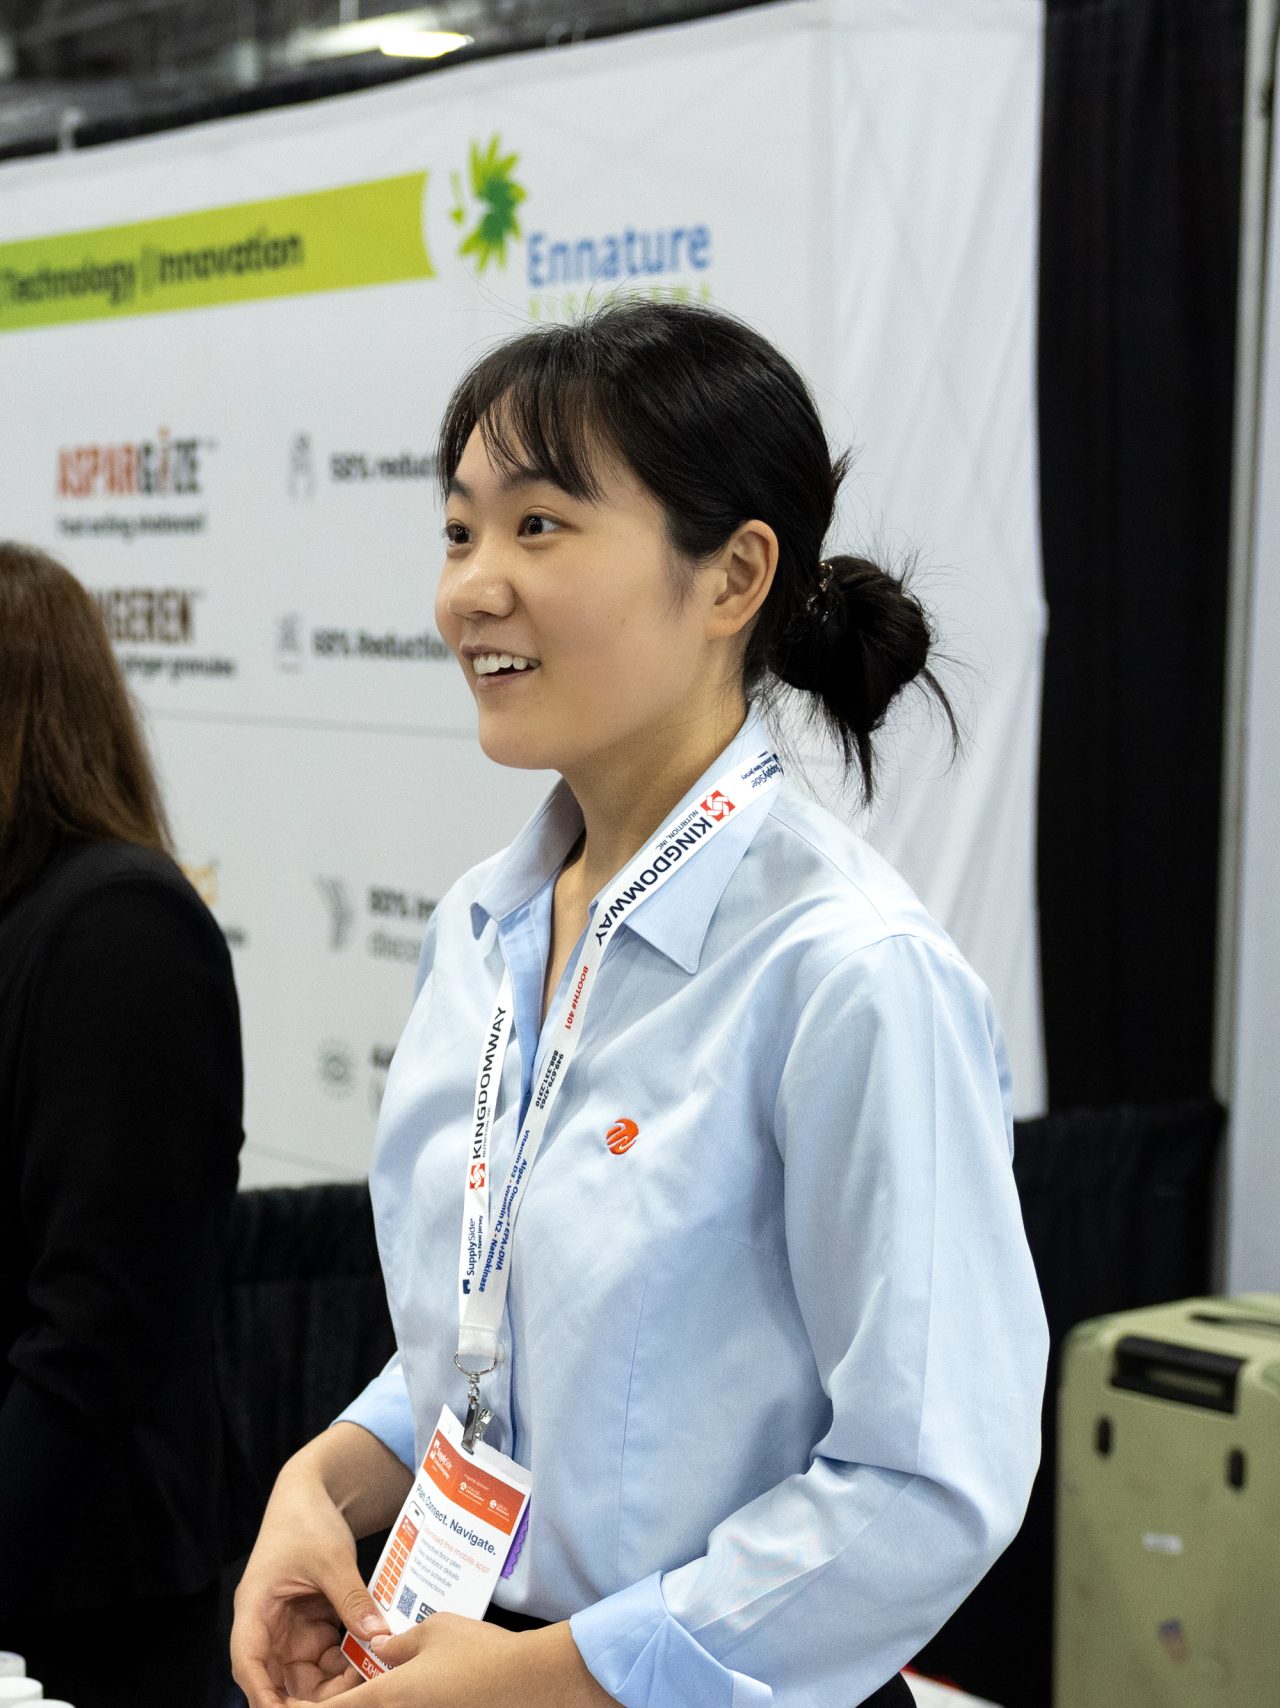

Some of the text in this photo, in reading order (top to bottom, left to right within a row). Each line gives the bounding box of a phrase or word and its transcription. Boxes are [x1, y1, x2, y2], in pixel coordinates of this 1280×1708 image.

[1, 260, 136, 306] Technology
[156, 227, 305, 285] Innovation
[528, 224, 711, 288] Ennature
[667, 810, 699, 840] NUTRITION,
[595, 816, 713, 946] KINGDOMWAY
[564, 965, 589, 1031] BOOTH# 401
[472, 1006, 507, 1160] KINGDOMWAY
[516, 1129, 530, 1160] Vitamin
[516, 1158, 528, 1185] Algae
[466, 1217, 478, 1276] SupplySide
[495, 1220, 504, 1233] K2
[495, 1227, 511, 1271] EPA+DHA
[478, 1238, 498, 1293] Nattokinase
[425, 1496, 448, 1526] Connect.
[449, 1518, 496, 1556] Navigate.
[361, 1656, 380, 1678] EXHI
